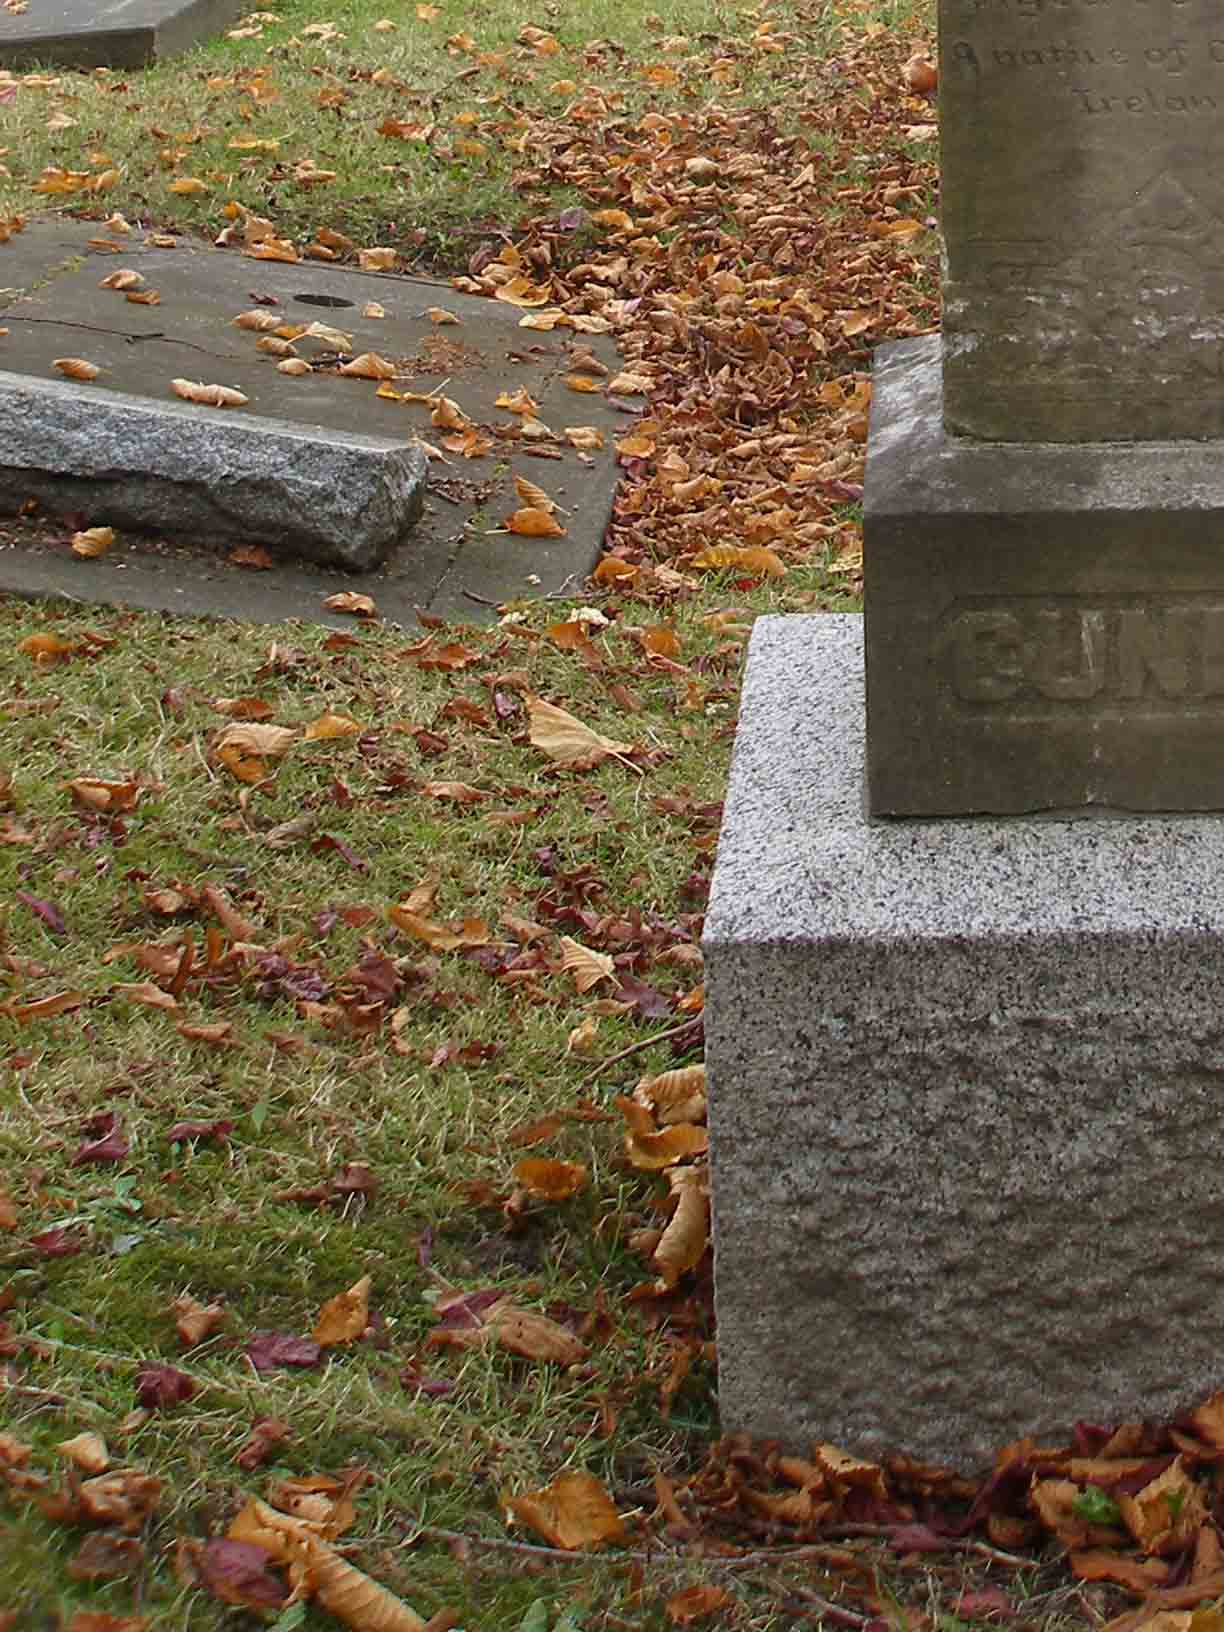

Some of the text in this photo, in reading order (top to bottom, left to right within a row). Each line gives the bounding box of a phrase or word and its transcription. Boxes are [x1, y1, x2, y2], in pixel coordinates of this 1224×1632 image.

[949, 39, 981, 71] A
[991, 39, 1131, 66] native
[1143, 38, 1191, 78] of
